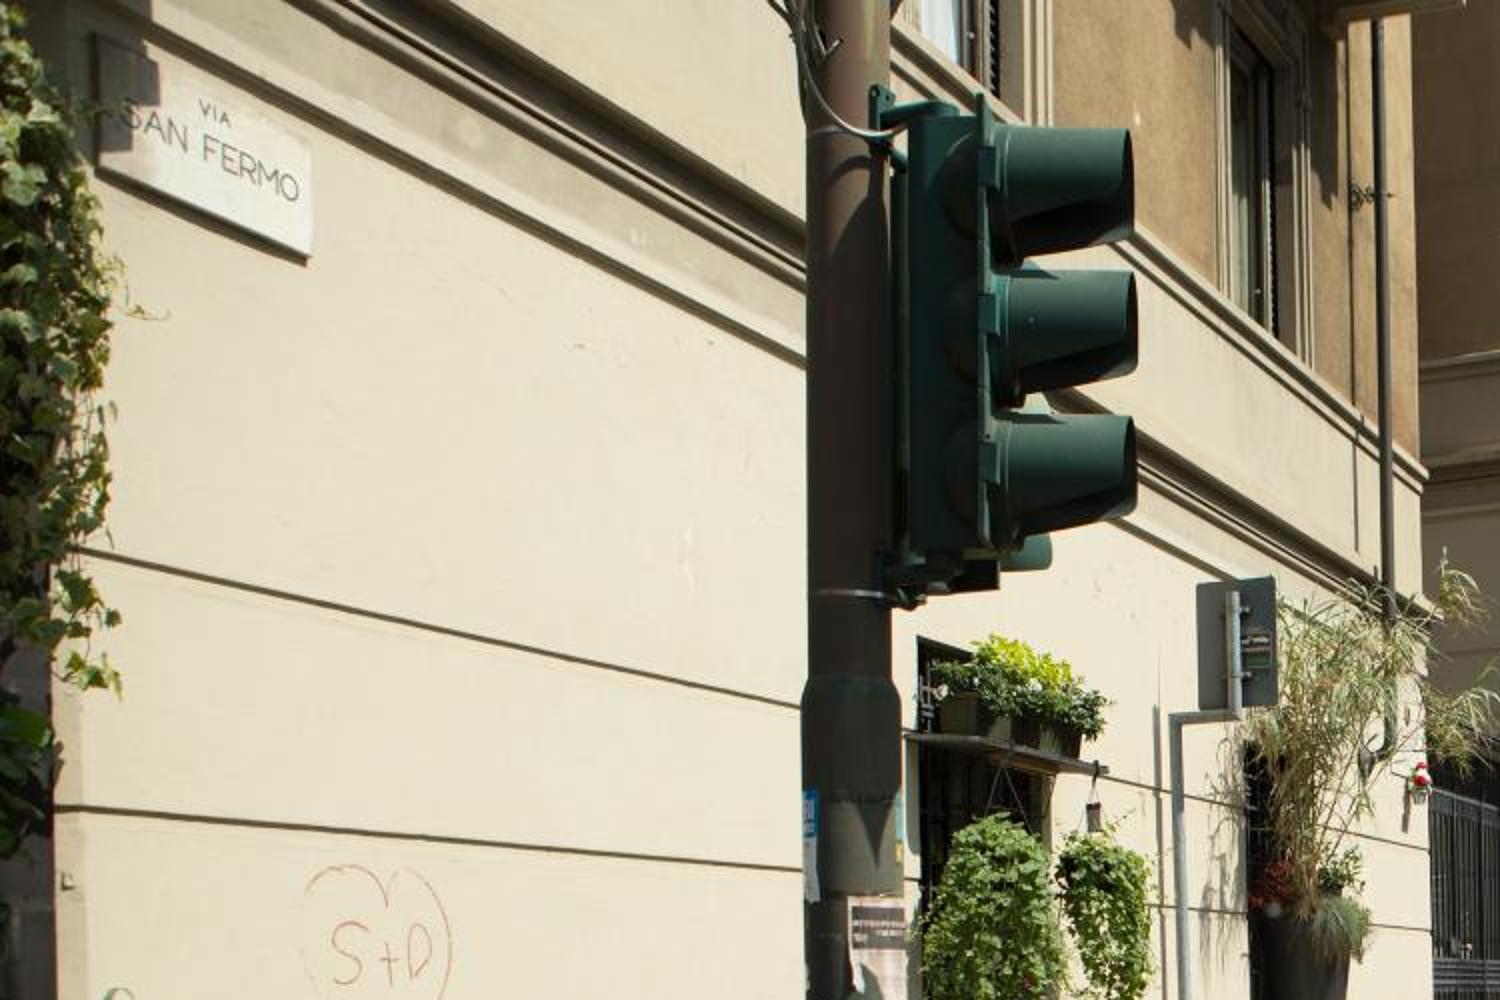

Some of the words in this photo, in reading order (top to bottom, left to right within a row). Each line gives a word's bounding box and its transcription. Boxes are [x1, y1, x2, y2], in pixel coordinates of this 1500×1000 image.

[198, 99, 233, 128] VIA
[122, 97, 189, 153] SAN
[202, 133, 300, 202] FERMO
